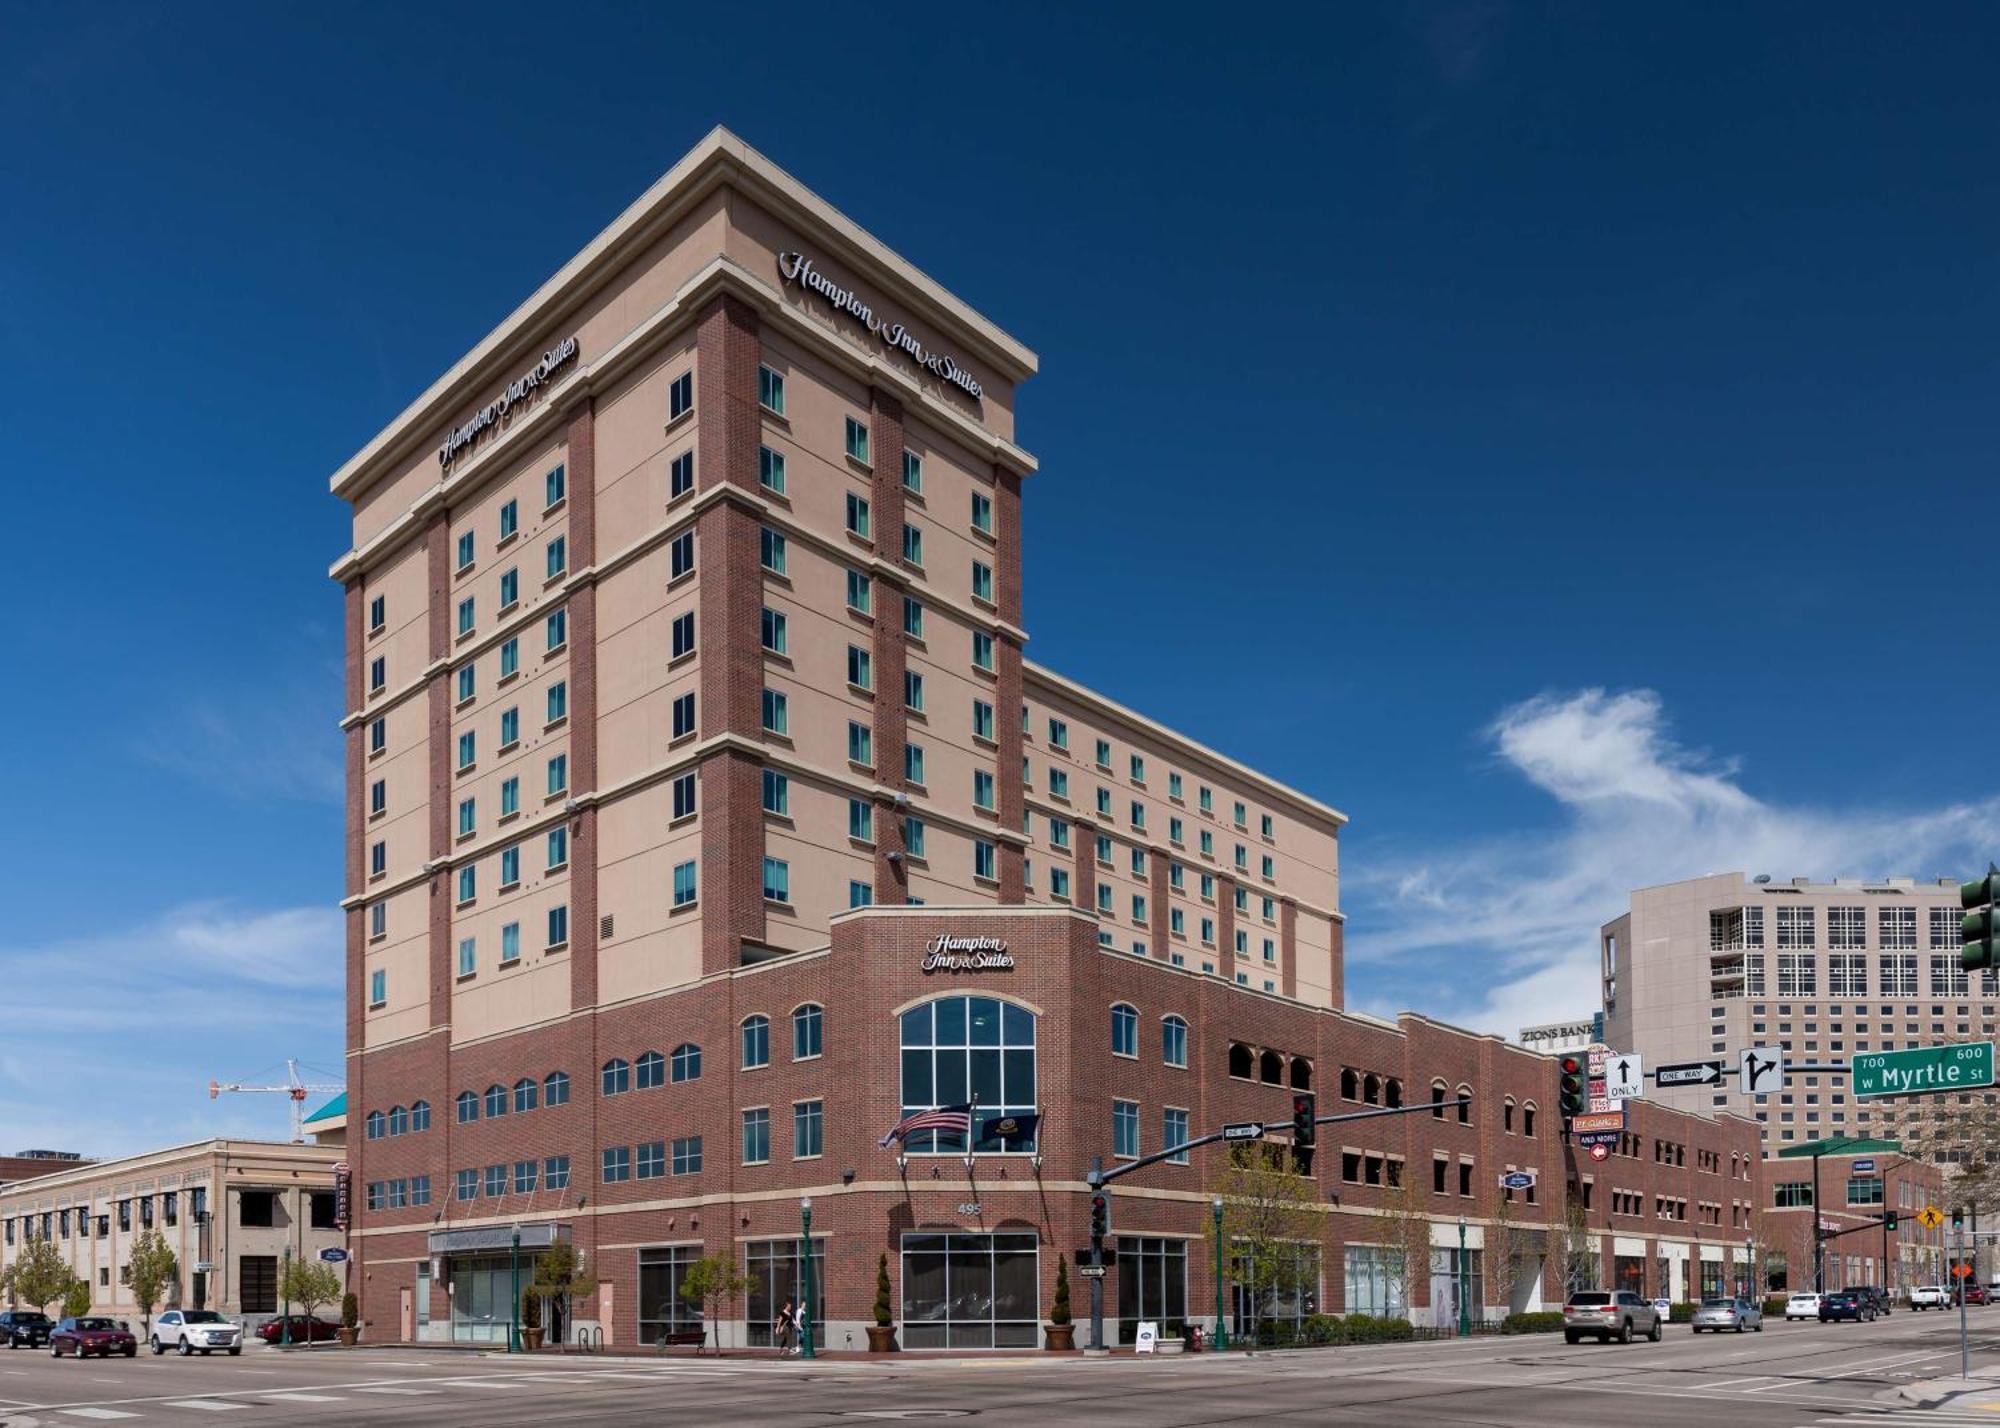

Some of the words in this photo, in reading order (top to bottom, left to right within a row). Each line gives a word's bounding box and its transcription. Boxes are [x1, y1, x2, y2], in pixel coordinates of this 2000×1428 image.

[779, 252, 880, 331] Hampton
[882, 324, 928, 363] Inn
[938, 355, 984, 400] Suites
[439, 404, 496, 466] Hampton
[537, 338, 576, 380] Suites
[926, 934, 1007, 953] Hampton
[920, 953, 962, 971] Inn
[970, 951, 1014, 968] Suites
[1521, 1028, 1558, 1041] ZIONS
[1560, 1023, 1596, 1037] BANK
[1956, 1048, 1982, 1060] 600
[1862, 1057, 1885, 1068] 700
[1662, 1071, 1680, 1080] ONE
[1683, 1070, 1702, 1078] WAY
[1862, 1079, 1873, 1088] W
[1882, 1062, 1960, 1091] Myrtle
[1970, 1069, 1983, 1079] St
[1611, 1085, 1638, 1097] ONLY
[1581, 1135, 1595, 1143] AND
[1597, 1133, 1617, 1142] MORE
[958, 1203, 982, 1215] 495
